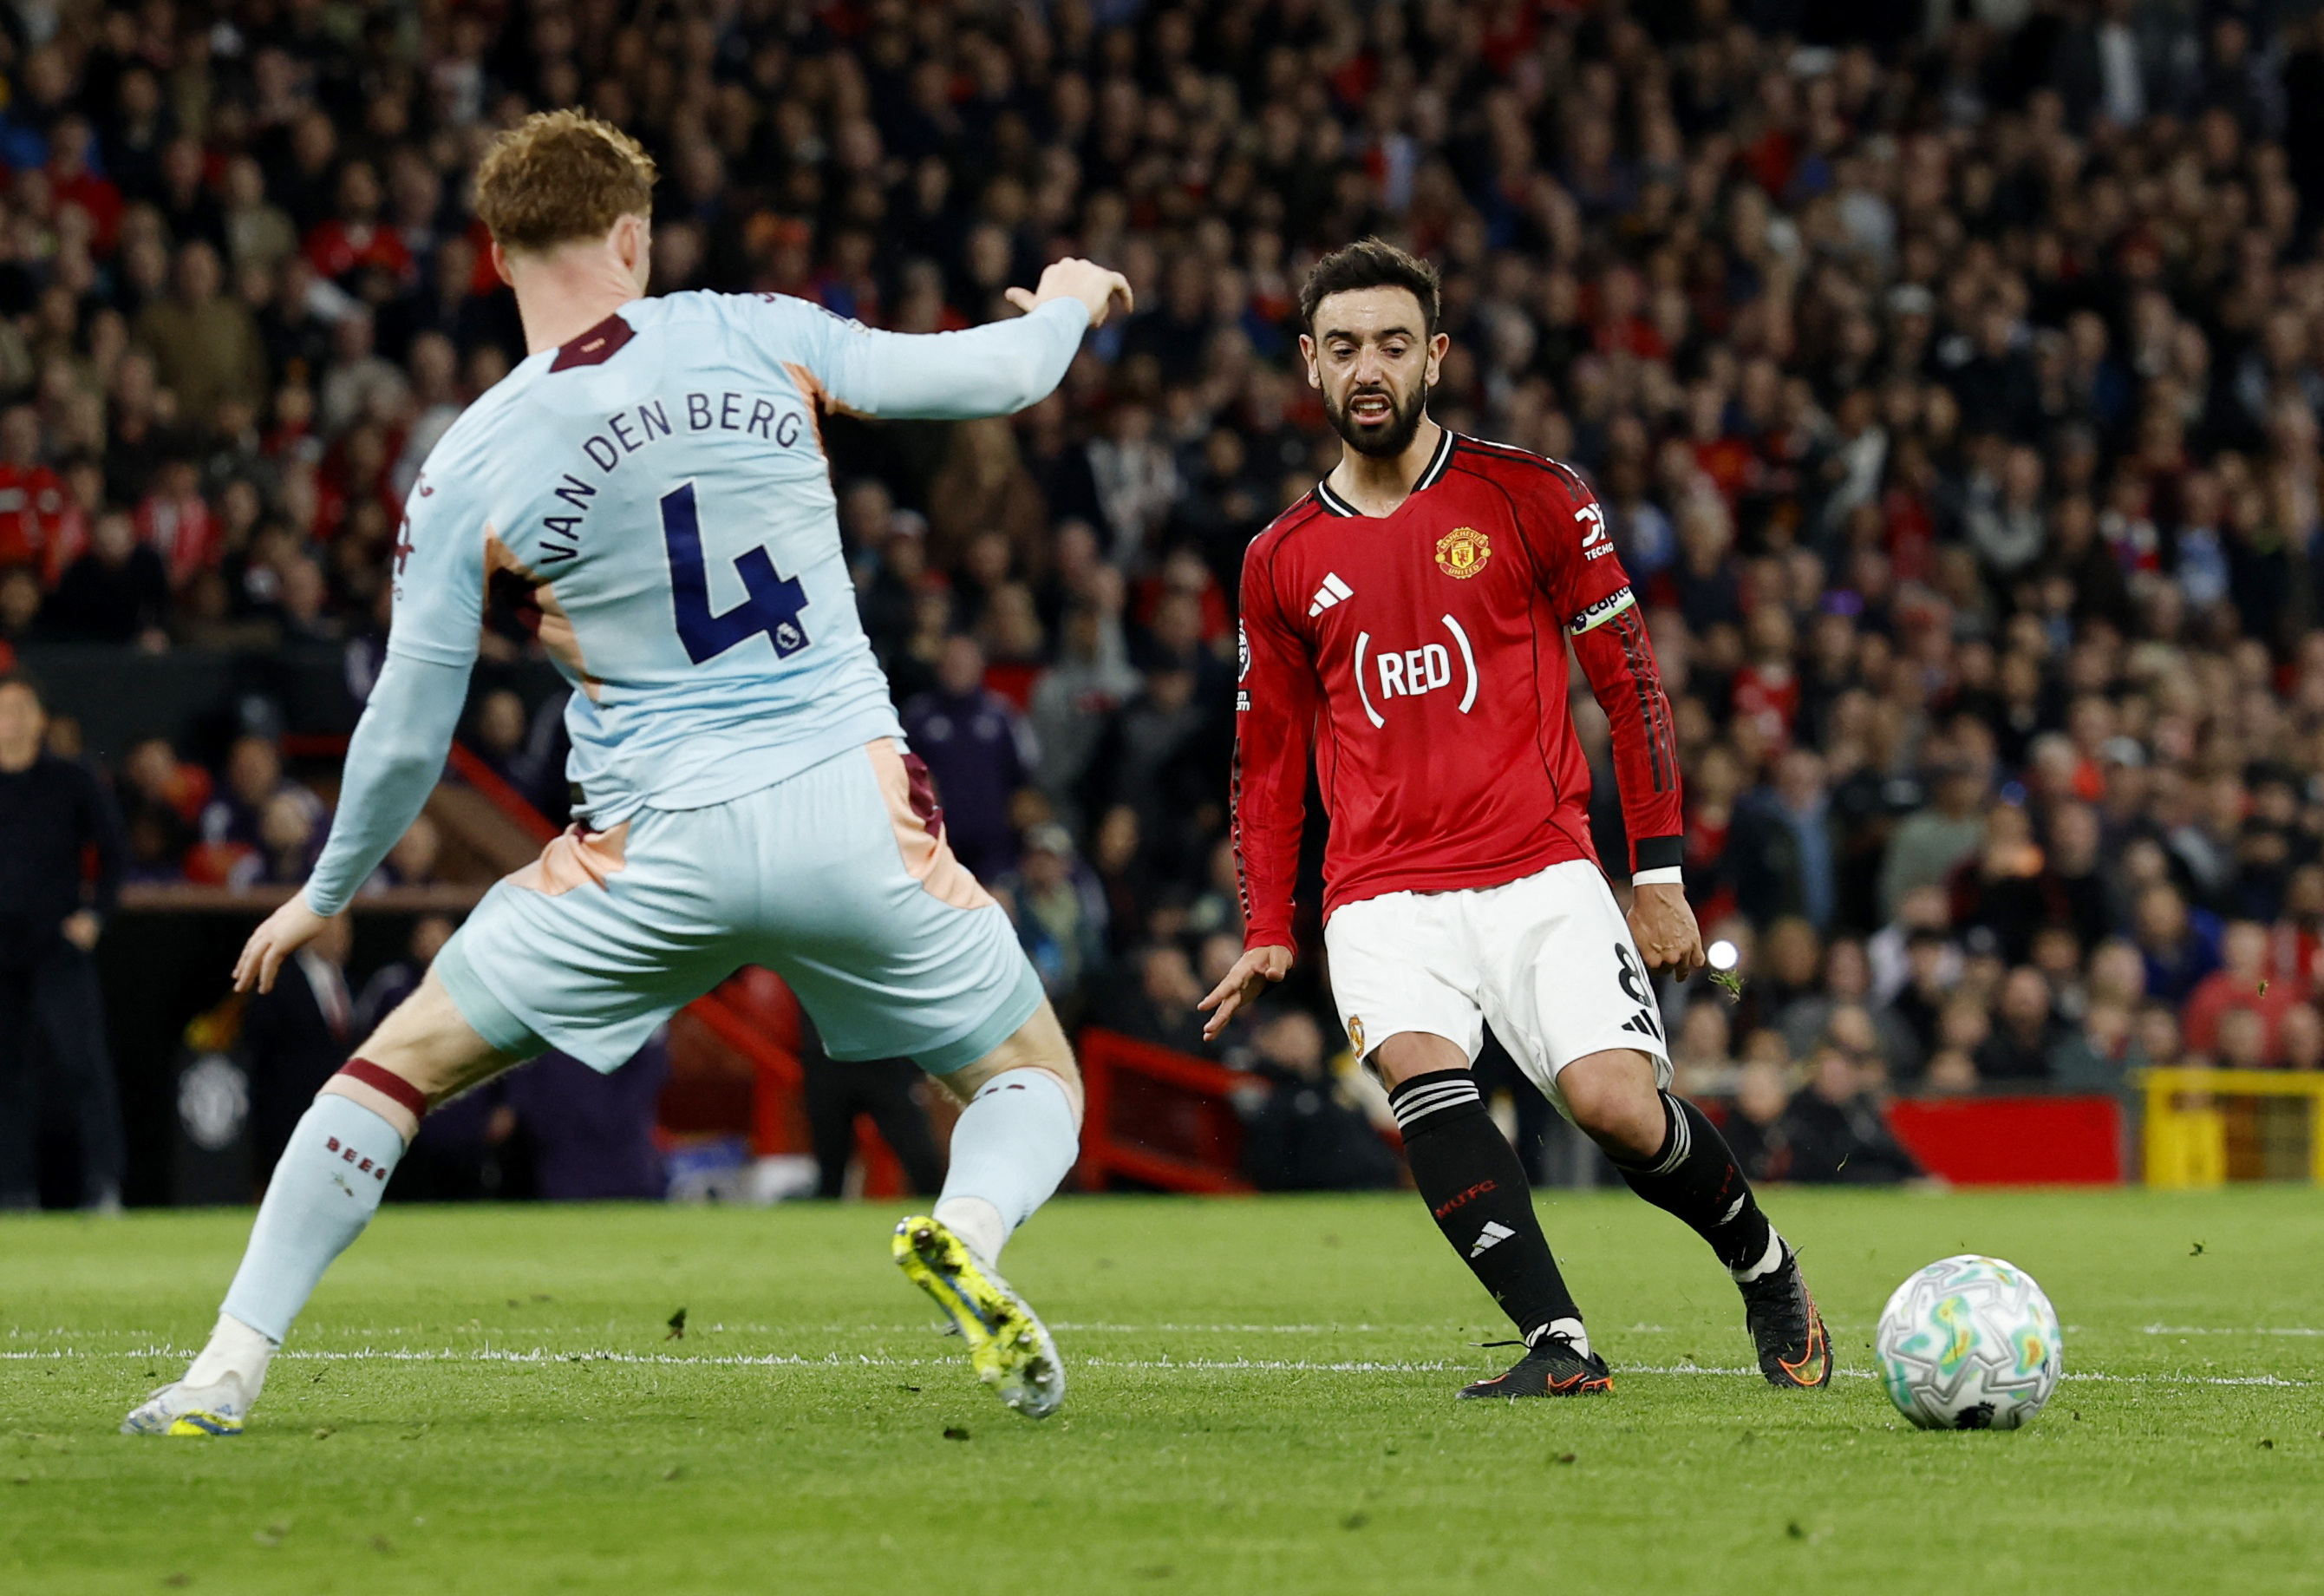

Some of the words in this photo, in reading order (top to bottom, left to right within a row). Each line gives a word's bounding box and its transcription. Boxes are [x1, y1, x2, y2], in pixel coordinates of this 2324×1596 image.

[539, 474, 597, 565] VAN
[583, 400, 673, 474] DEN
[686, 391, 803, 449] BERG
[659, 479, 812, 667] 4
[1448, 564, 1479, 575] UNITED
[1614, 942, 1653, 1009] 8
[325, 1135, 387, 1181] BEES
